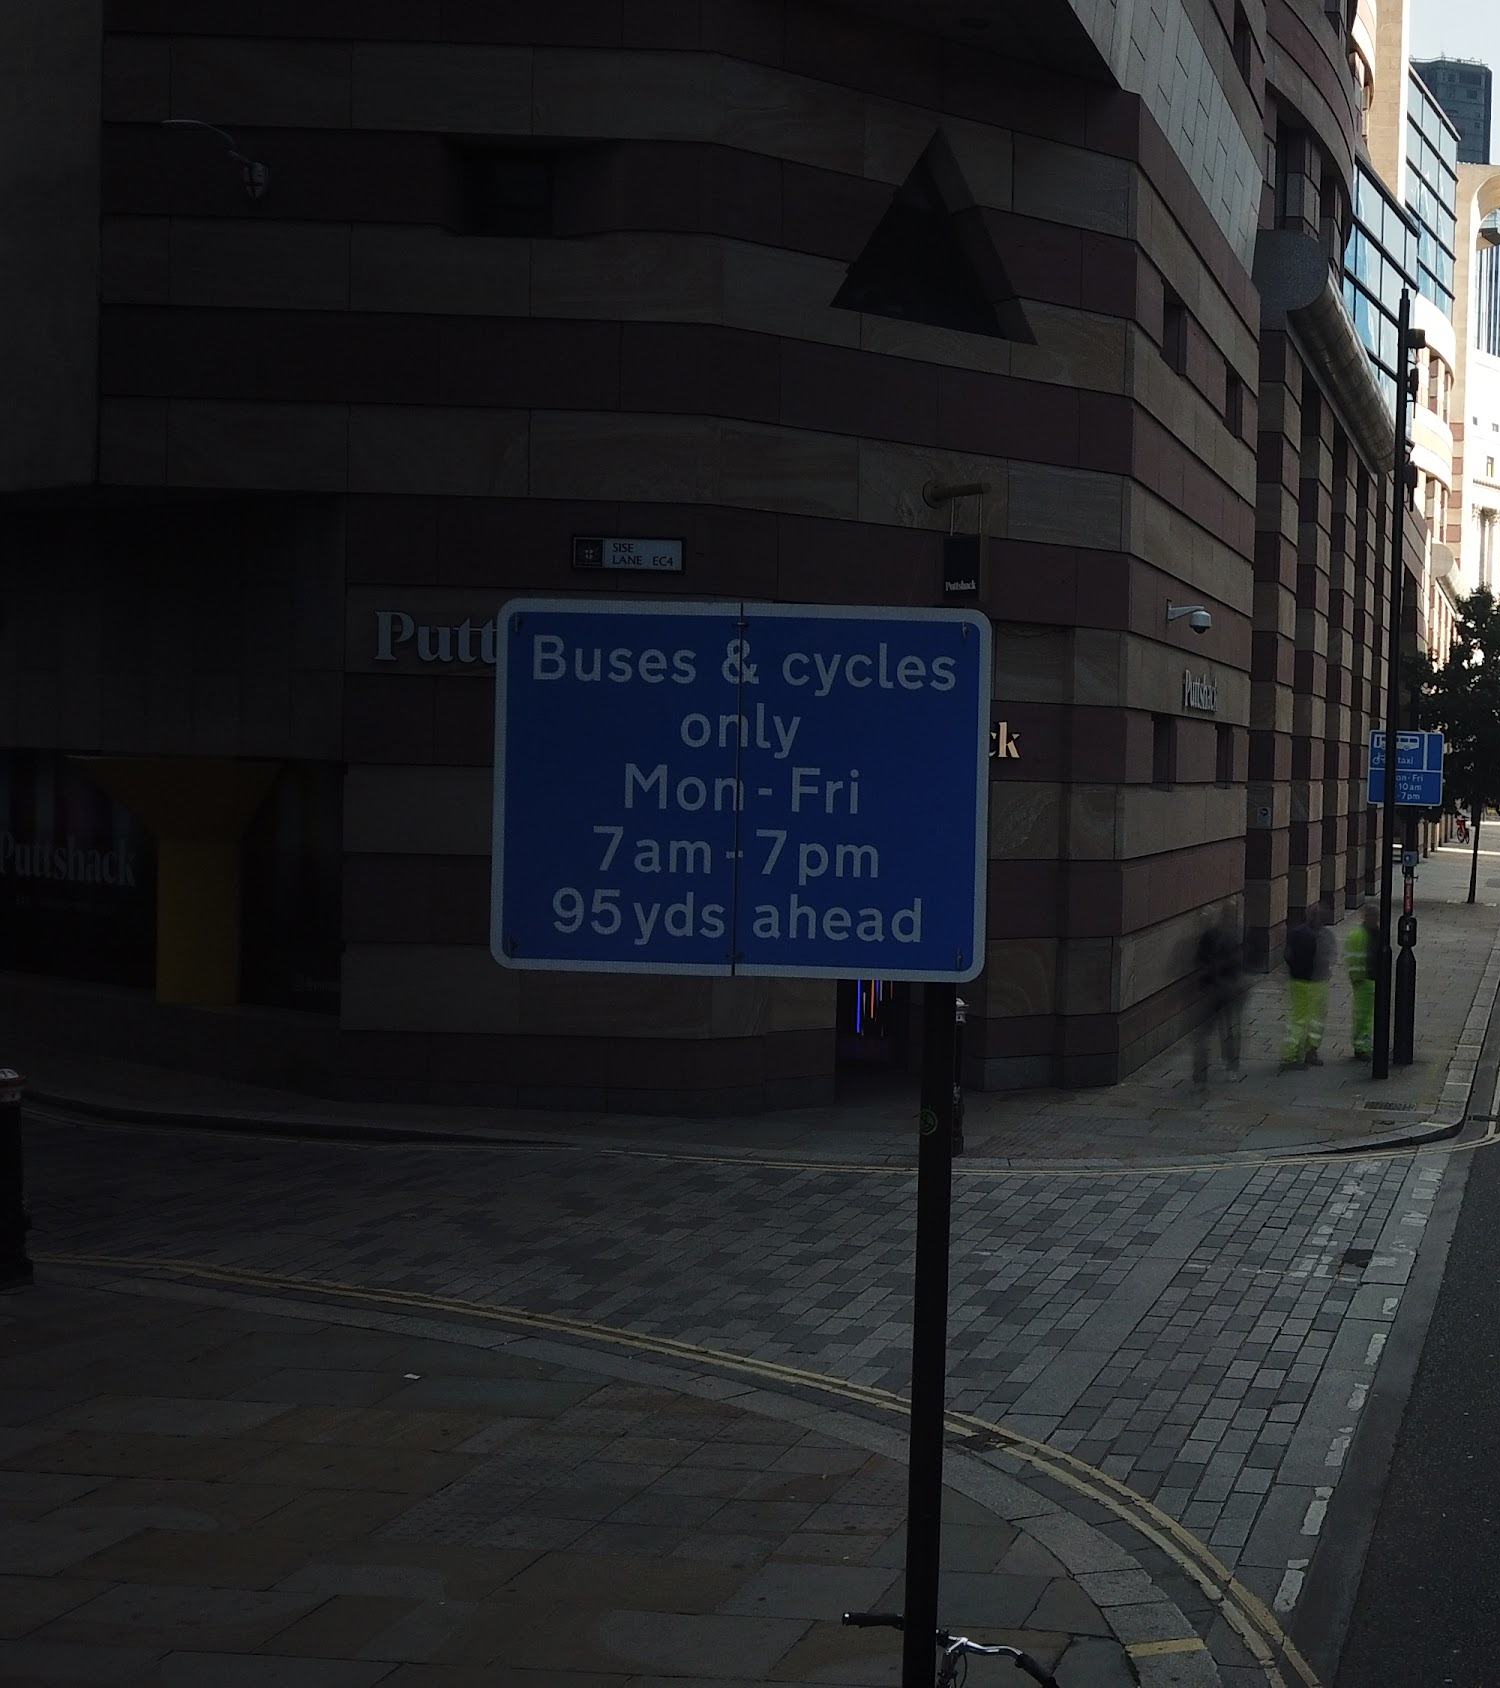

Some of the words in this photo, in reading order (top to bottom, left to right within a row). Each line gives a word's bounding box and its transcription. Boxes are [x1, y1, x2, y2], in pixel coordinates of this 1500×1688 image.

[612, 543, 634, 553] SISE
[612, 555, 643, 565] LANE
[653, 556, 673, 567] EC4
[373, 610, 498, 664] Putt
[533, 634, 697, 684] Buses
[721, 638, 760, 685] &
[782, 642, 956, 698] cycles
[680, 702, 802, 760] only
[1397, 756, 1414, 765] taxi
[791, 766, 860, 815] Fri
[0, 831, 137, 889] Puttshack
[752, 893, 922, 943] ahead
